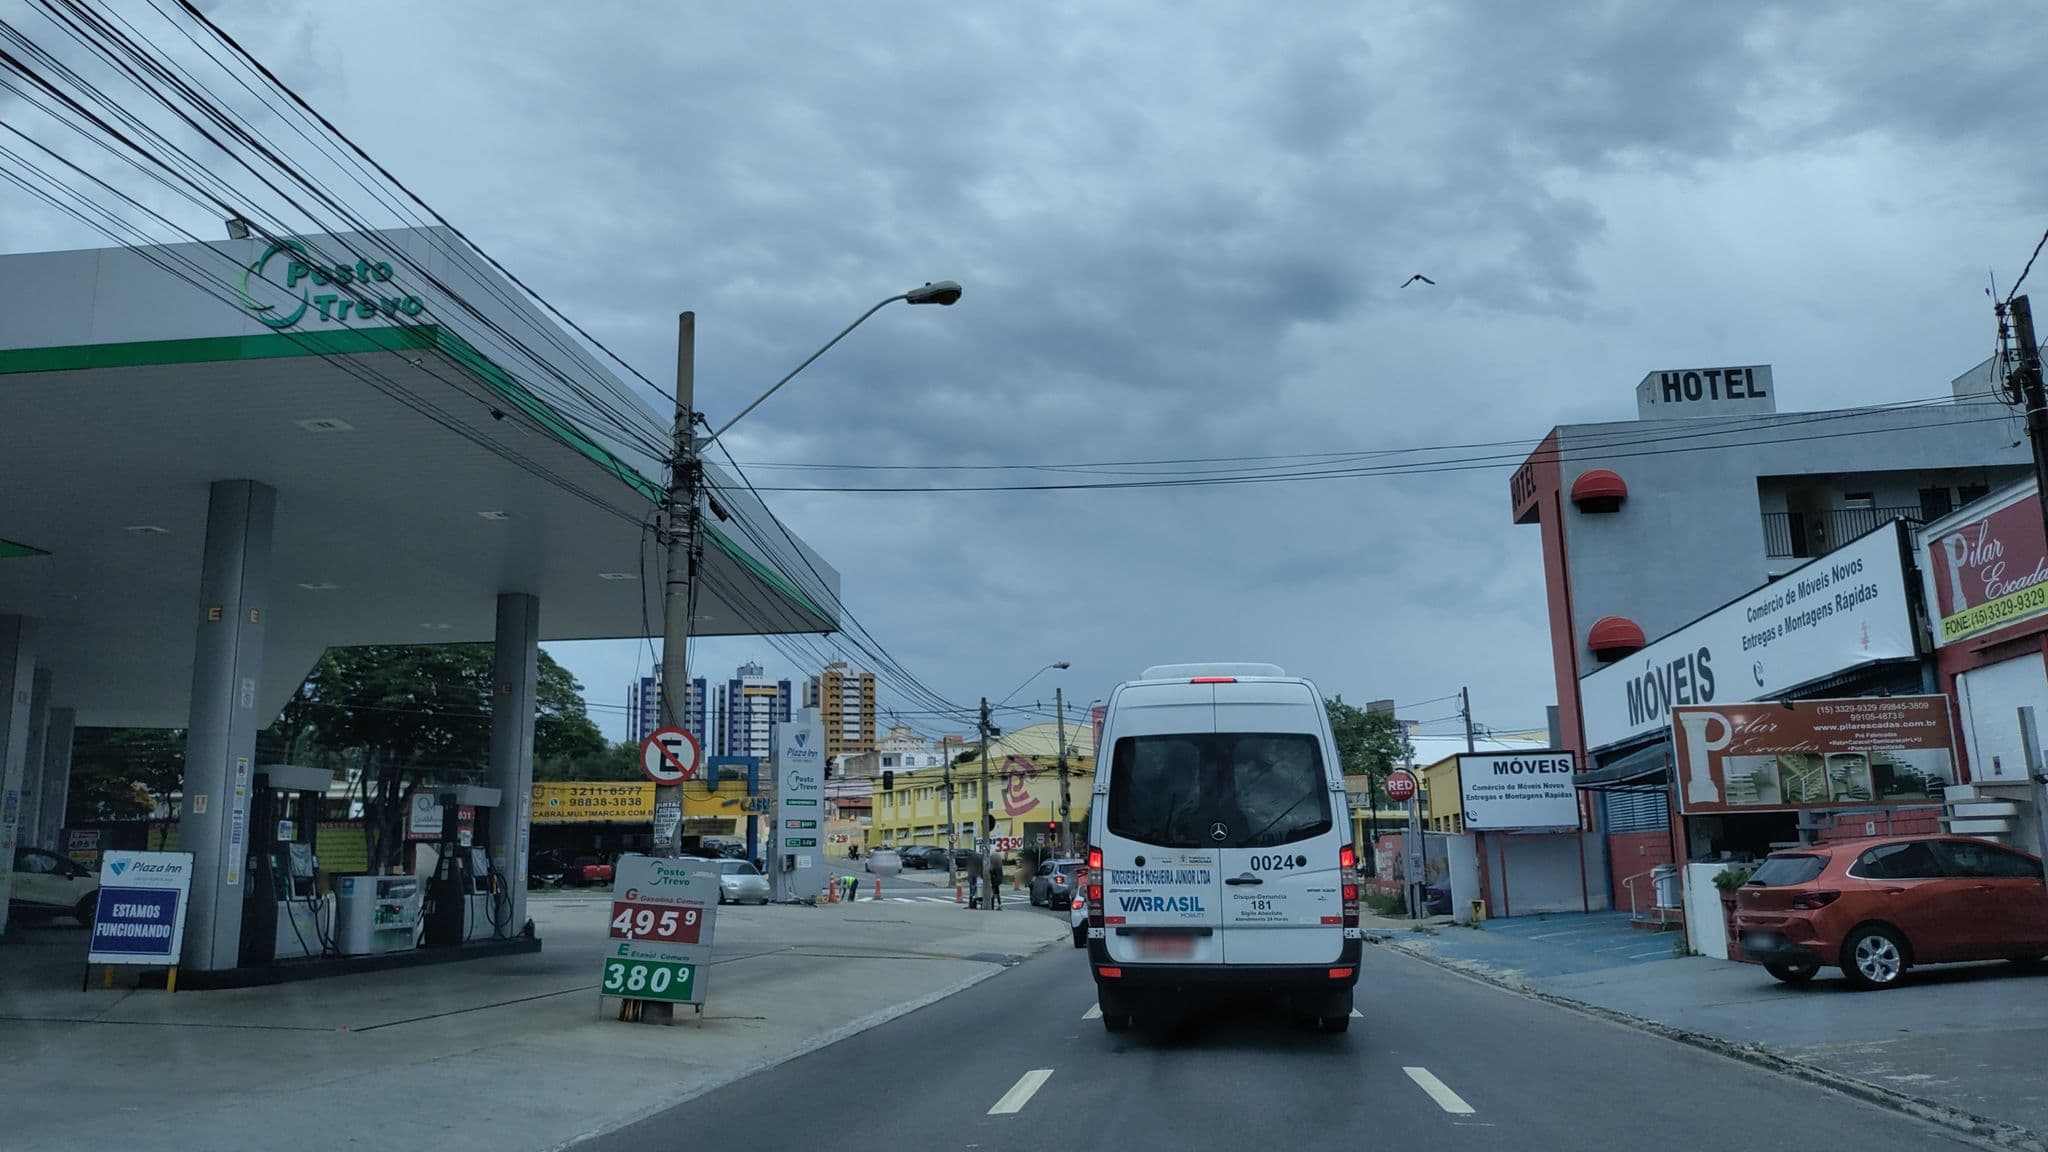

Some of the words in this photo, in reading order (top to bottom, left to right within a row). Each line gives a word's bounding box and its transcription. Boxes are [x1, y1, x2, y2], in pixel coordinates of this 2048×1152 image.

[286, 258, 393, 288] Posto
[313, 295, 425, 321] Trevo
[1661, 369, 1767, 402] HOTEL
[1511, 463, 1537, 512] HOTEL
[1747, 594, 1784, 623] Comércio
[1785, 588, 1797, 606] de
[1798, 571, 1830, 600] Móveis
[1831, 558, 1863, 584] Novos
[1989, 587, 2046, 621] 3329-9329
[1742, 626, 1776, 651] Entregas
[1777, 624, 1784, 637] e
[1784, 602, 1833, 634] Montagens
[1835, 583, 1879, 613] Rápidas
[1626, 646, 1715, 727] MÓVEIS
[1817, 704, 1833, 716] (15)
[1835, 703, 1877, 713] 3329-9329
[1813, 720, 1937, 732] www.pilarescadas.com.br
[787, 747, 807, 757] Plaza
[807, 749, 818, 758] Inn
[1493, 757, 1570, 775] MÓVEIS
[1388, 780, 1413, 791] RED
[1472, 783, 1505, 791] Comércio
[1517, 782, 1541, 790] Móveis
[569, 797, 642, 807] 98838-3838
[1466, 793, 1497, 802] Entregas
[1505, 792, 1543, 800] Montagens
[1545, 791, 1573, 799] Rápidas
[131, 862, 165, 873] Plaza
[166, 863, 183, 873] Inn
[1250, 855, 1295, 871] 0024
[657, 867, 686, 877] Posto
[1111, 869, 1139, 885] NOGUEIRA
[1146, 869, 1174, 885] NOGUEIRA
[1175, 869, 1197, 885] JUNIOR
[1197, 869, 1211, 885] LTDA
[662, 877, 690, 886] Trevo
[625, 888, 639, 901] G
[112, 903, 160, 918] ESTAMOS
[1119, 896, 1205, 912] VIABRASIL
[1251, 900, 1271, 910] 181
[96, 922, 171, 938] FUNCIONANDO
[618, 943, 630, 956] E
